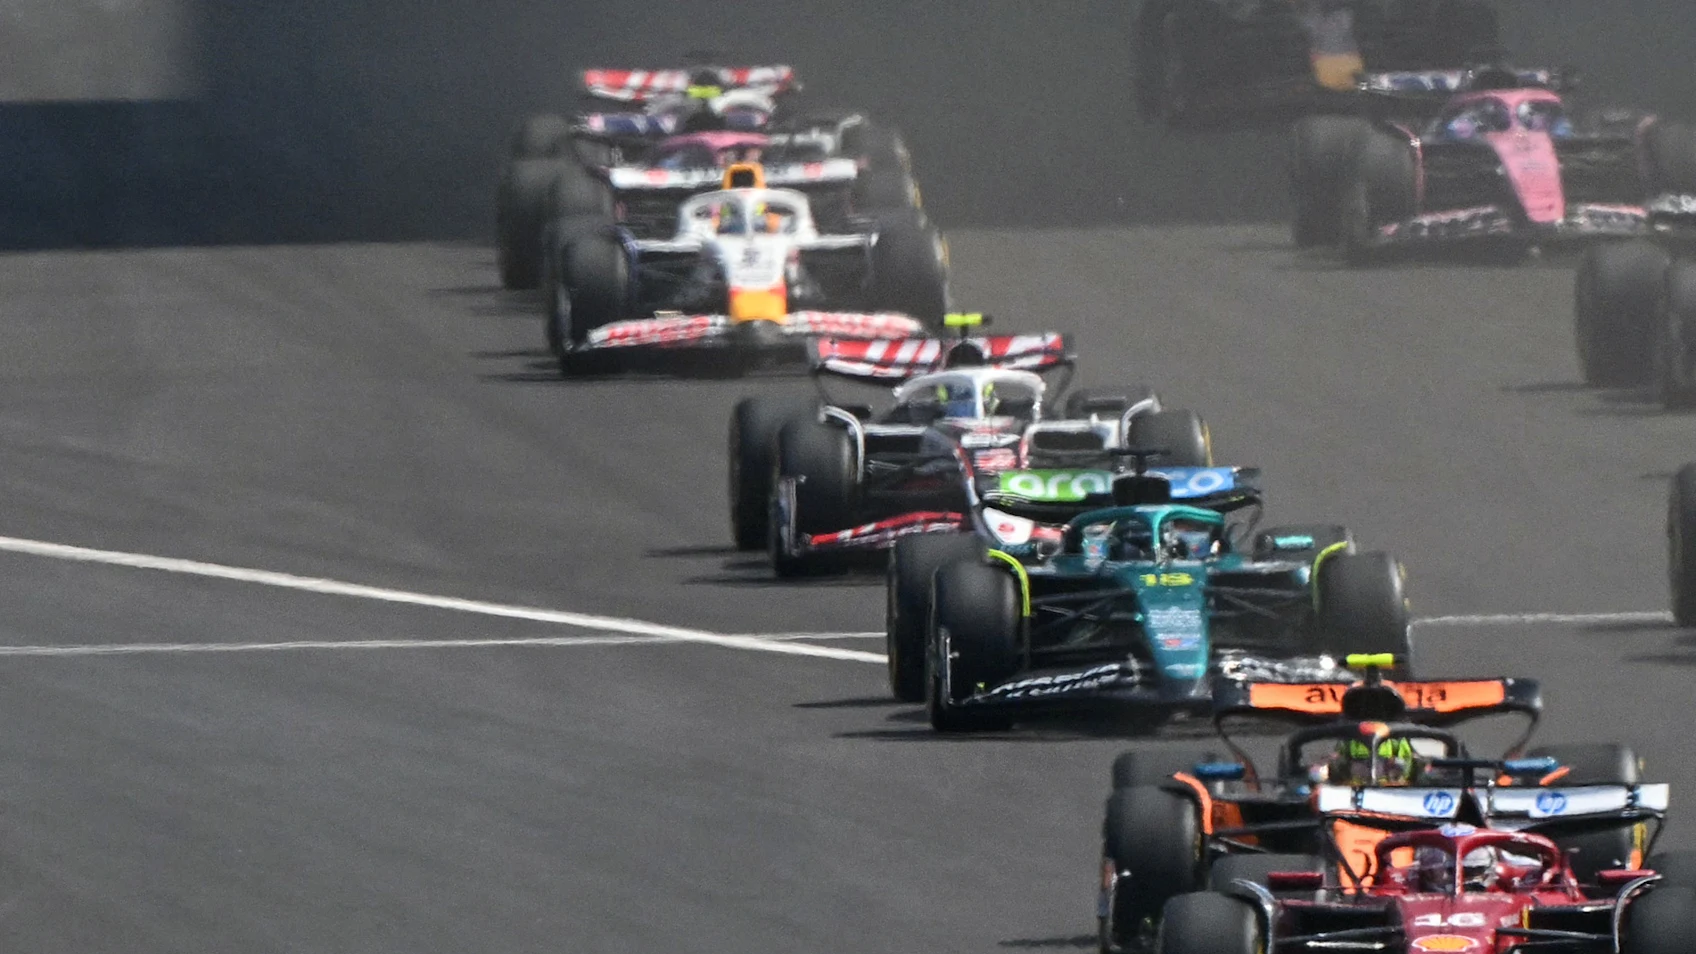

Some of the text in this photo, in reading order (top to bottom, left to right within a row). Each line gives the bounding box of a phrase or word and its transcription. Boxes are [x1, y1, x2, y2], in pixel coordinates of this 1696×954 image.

[1424, 790, 1455, 815] hp
[1537, 790, 1567, 815] hp
[1414, 912, 1485, 927] 16
